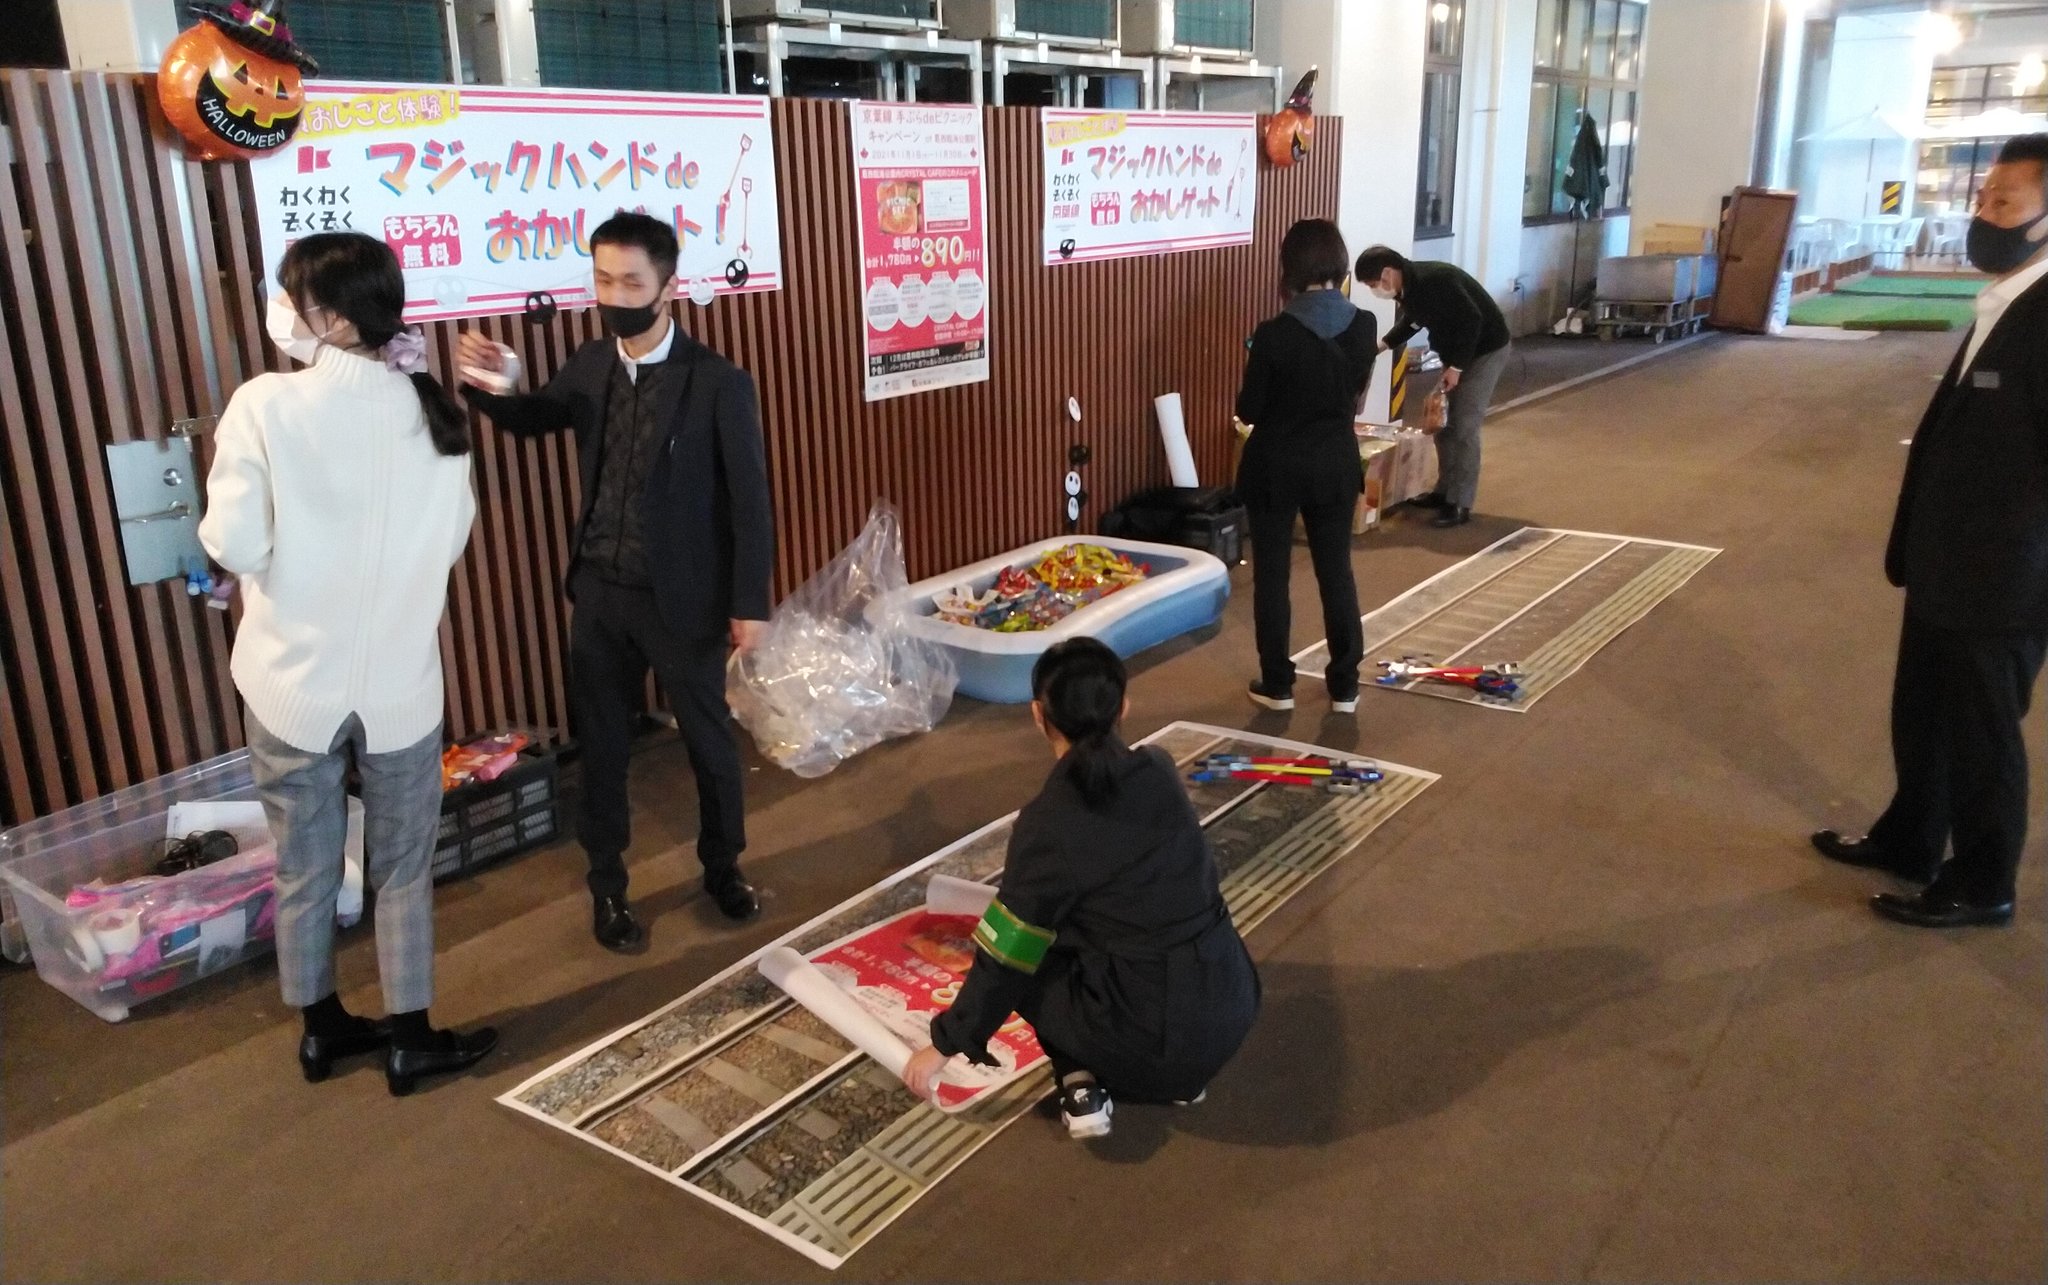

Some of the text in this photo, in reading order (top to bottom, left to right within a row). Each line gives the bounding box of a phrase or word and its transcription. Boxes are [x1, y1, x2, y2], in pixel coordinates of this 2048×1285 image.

[202, 98, 286, 148] HALLOWEEN
[868, 130, 921, 143] キャンペーン
[366, 139, 700, 196] マジックハンドde
[1087, 143, 1223, 180] マジックハンドde
[1053, 173, 1080, 187] わくわく
[280, 185, 350, 207] わくわく
[1092, 192, 1121, 208] もちろん
[384, 215, 459, 240] もちろん
[486, 203, 728, 263] おかしト!
[402, 242, 450, 268] 無料
